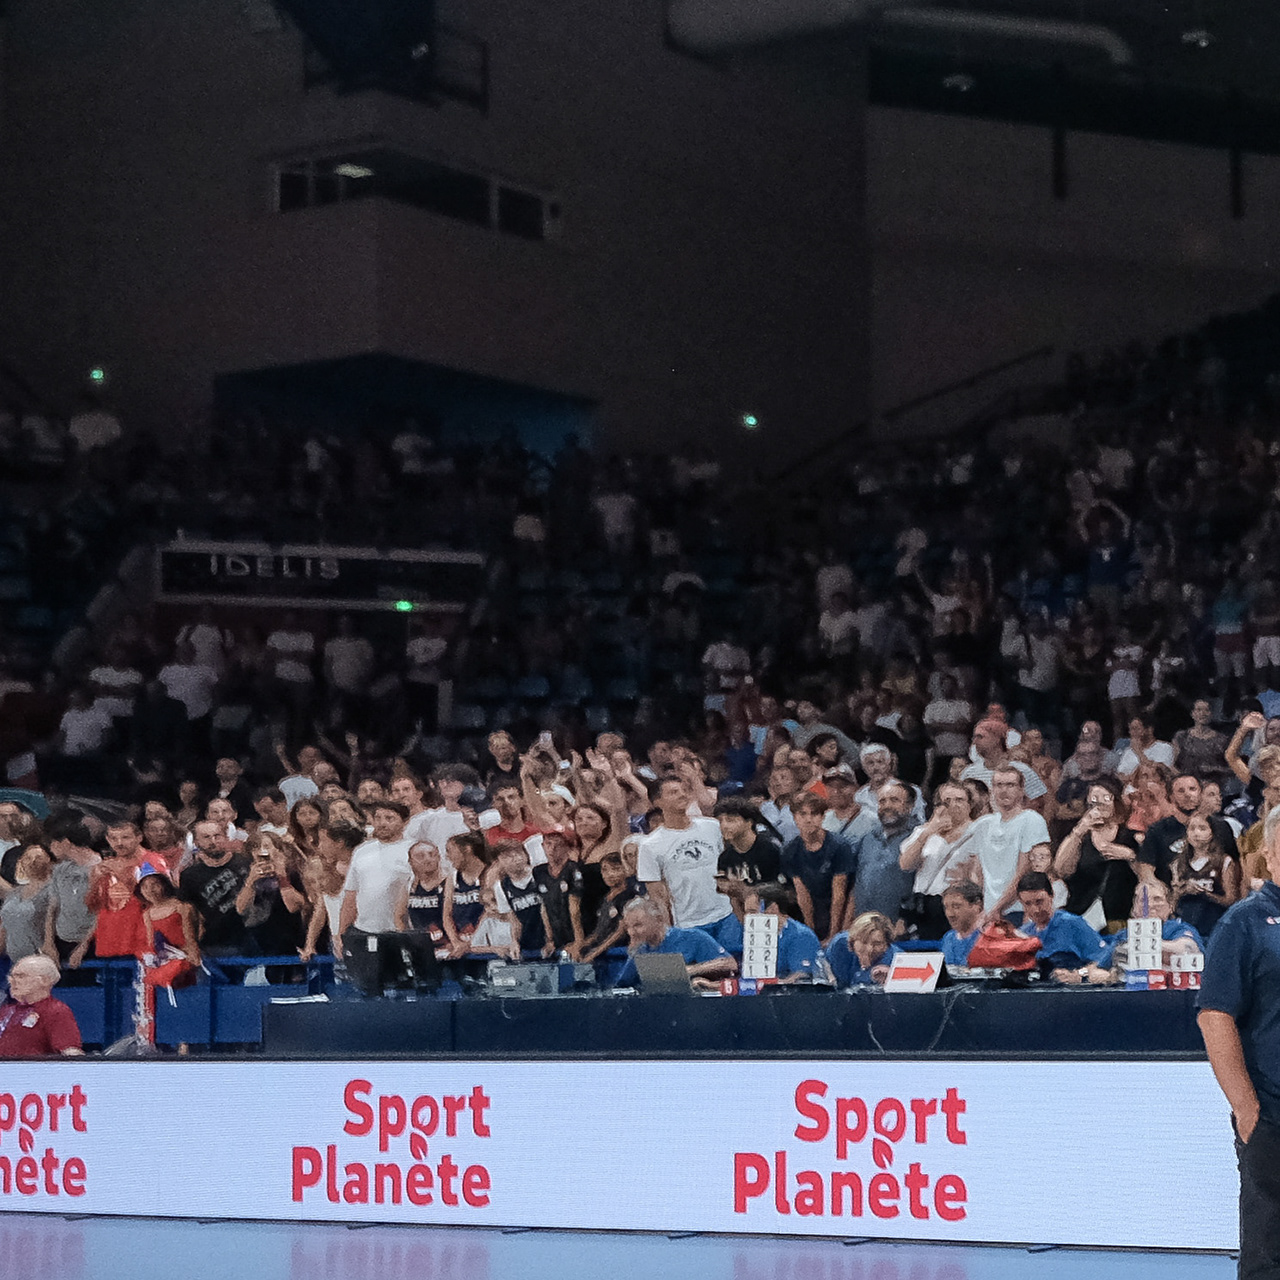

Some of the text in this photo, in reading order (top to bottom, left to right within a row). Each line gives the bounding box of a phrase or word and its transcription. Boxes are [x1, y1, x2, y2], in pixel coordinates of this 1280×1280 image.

[764, 949, 771, 962] 2
[0, 1085, 88, 1133] port
[343, 1078, 492, 1152] Sport
[794, 1079, 968, 1161] Sport
